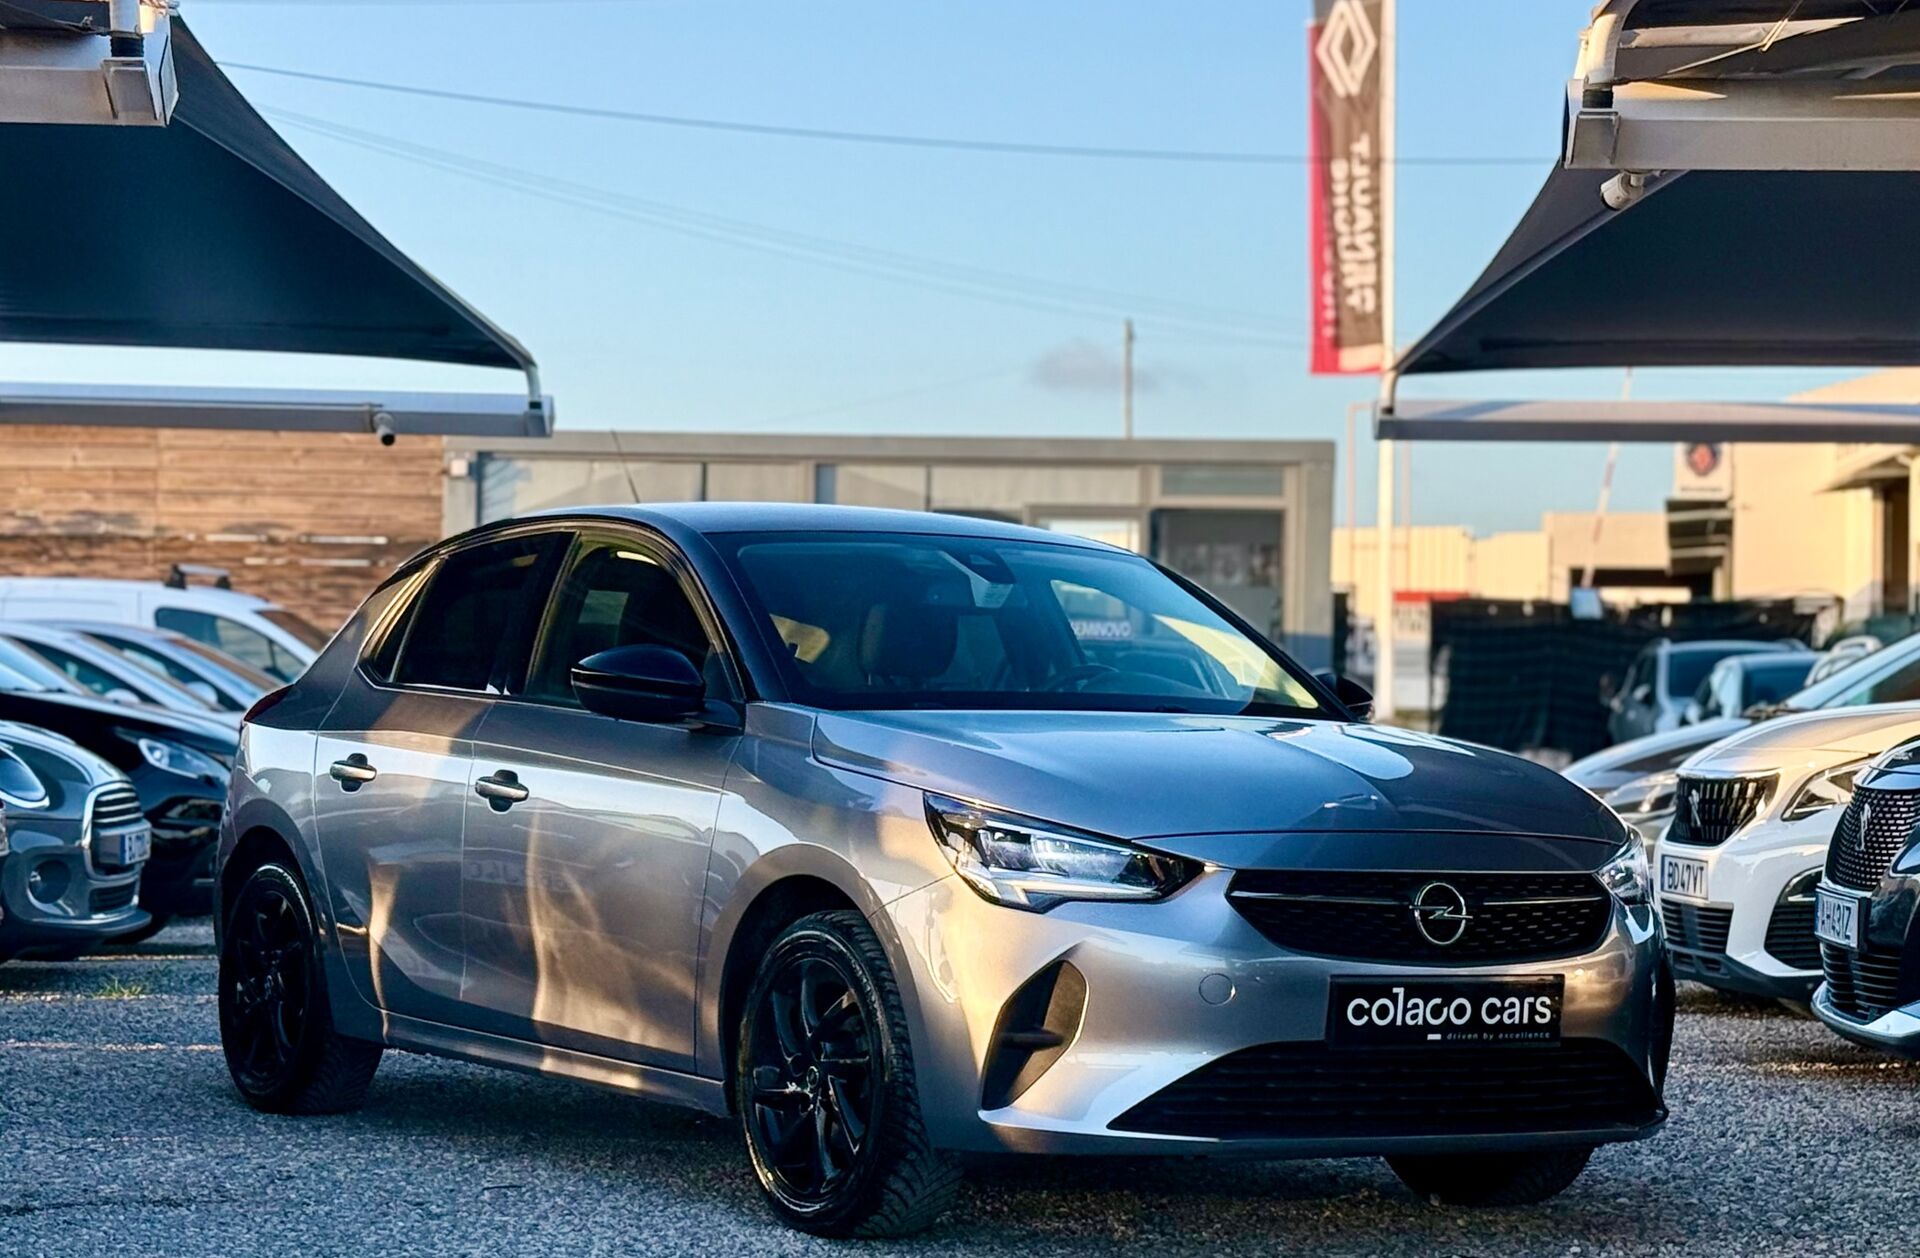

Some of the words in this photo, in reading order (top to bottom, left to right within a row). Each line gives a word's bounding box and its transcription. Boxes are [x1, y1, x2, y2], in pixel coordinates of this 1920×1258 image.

[1481, 996, 1552, 1025] cars
[1447, 1032, 1478, 1040] driven
[1483, 1032, 1494, 1040] by
